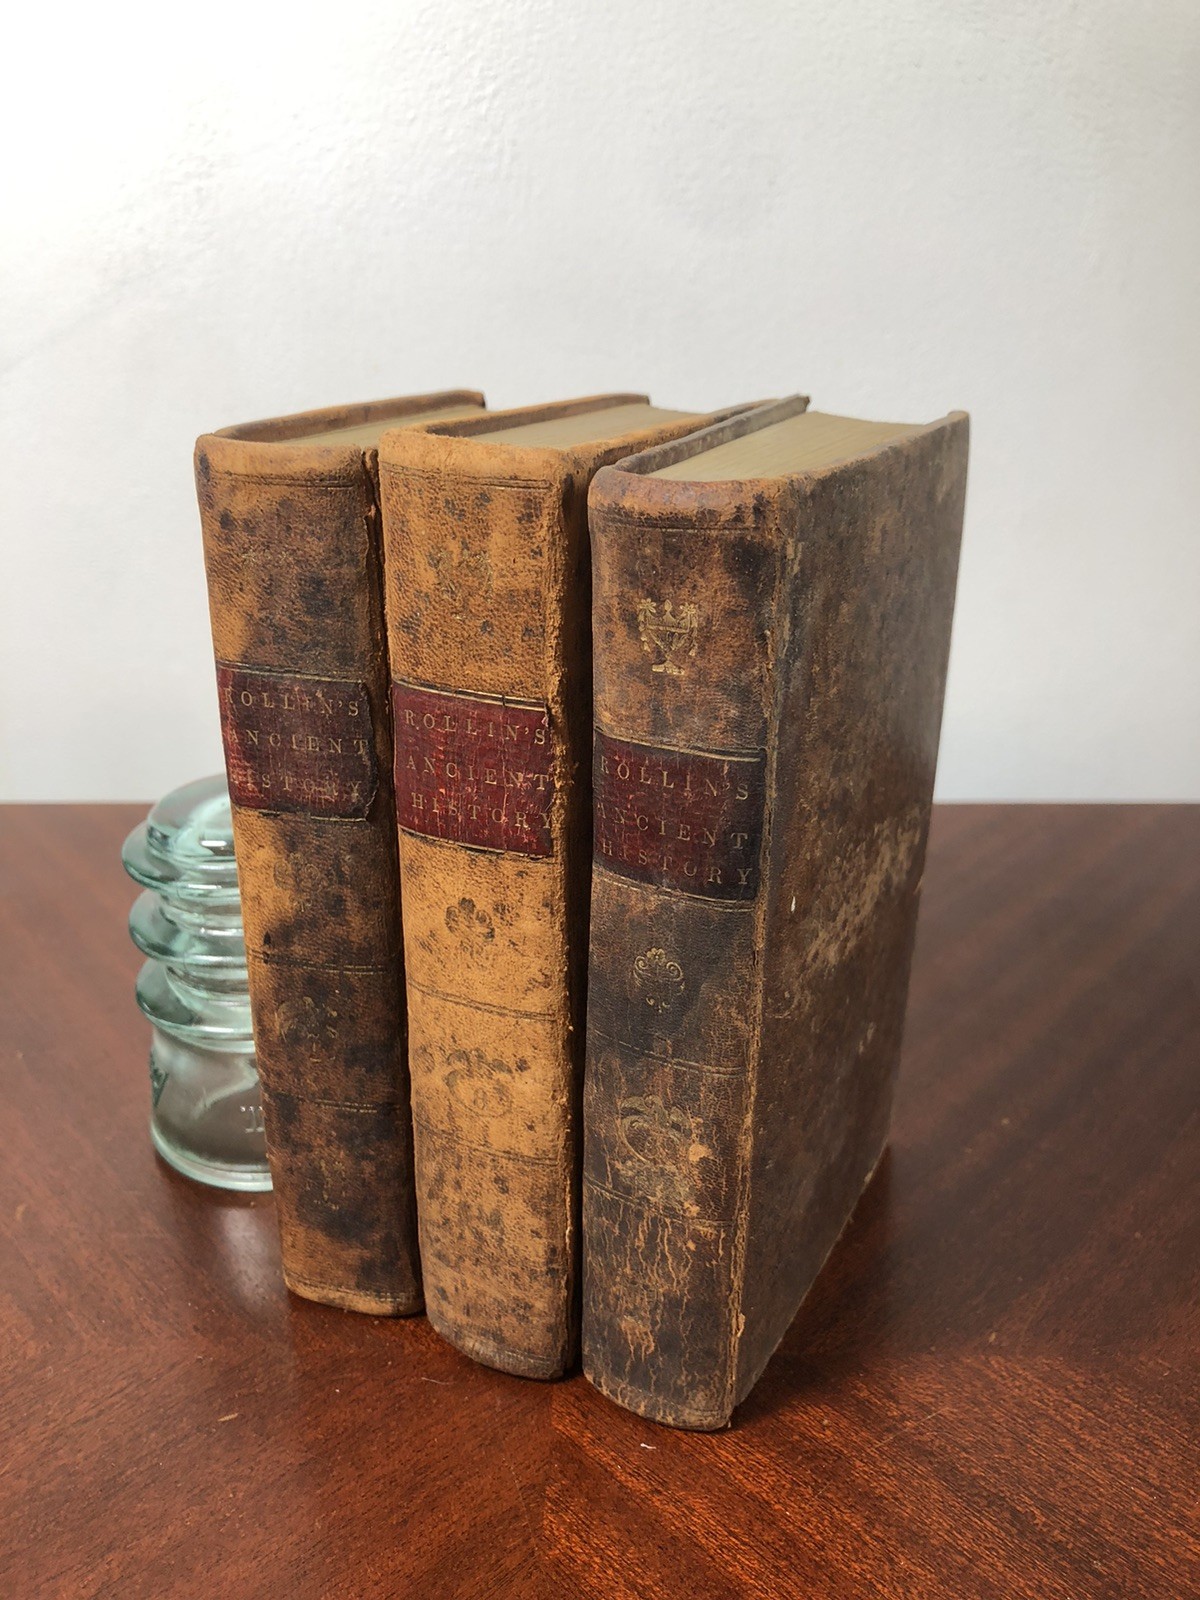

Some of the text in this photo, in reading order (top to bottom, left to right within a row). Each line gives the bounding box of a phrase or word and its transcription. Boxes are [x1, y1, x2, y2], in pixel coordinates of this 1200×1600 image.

[404, 709, 546, 745] ROLLIN'S
[406, 755, 549, 791] ANCIENT
[600, 755, 749, 801] ROLLIN'S
[411, 792, 551, 829] HISTORY
[597, 802, 748, 848] ANCIENT
[602, 838, 752, 885] HISTORY
